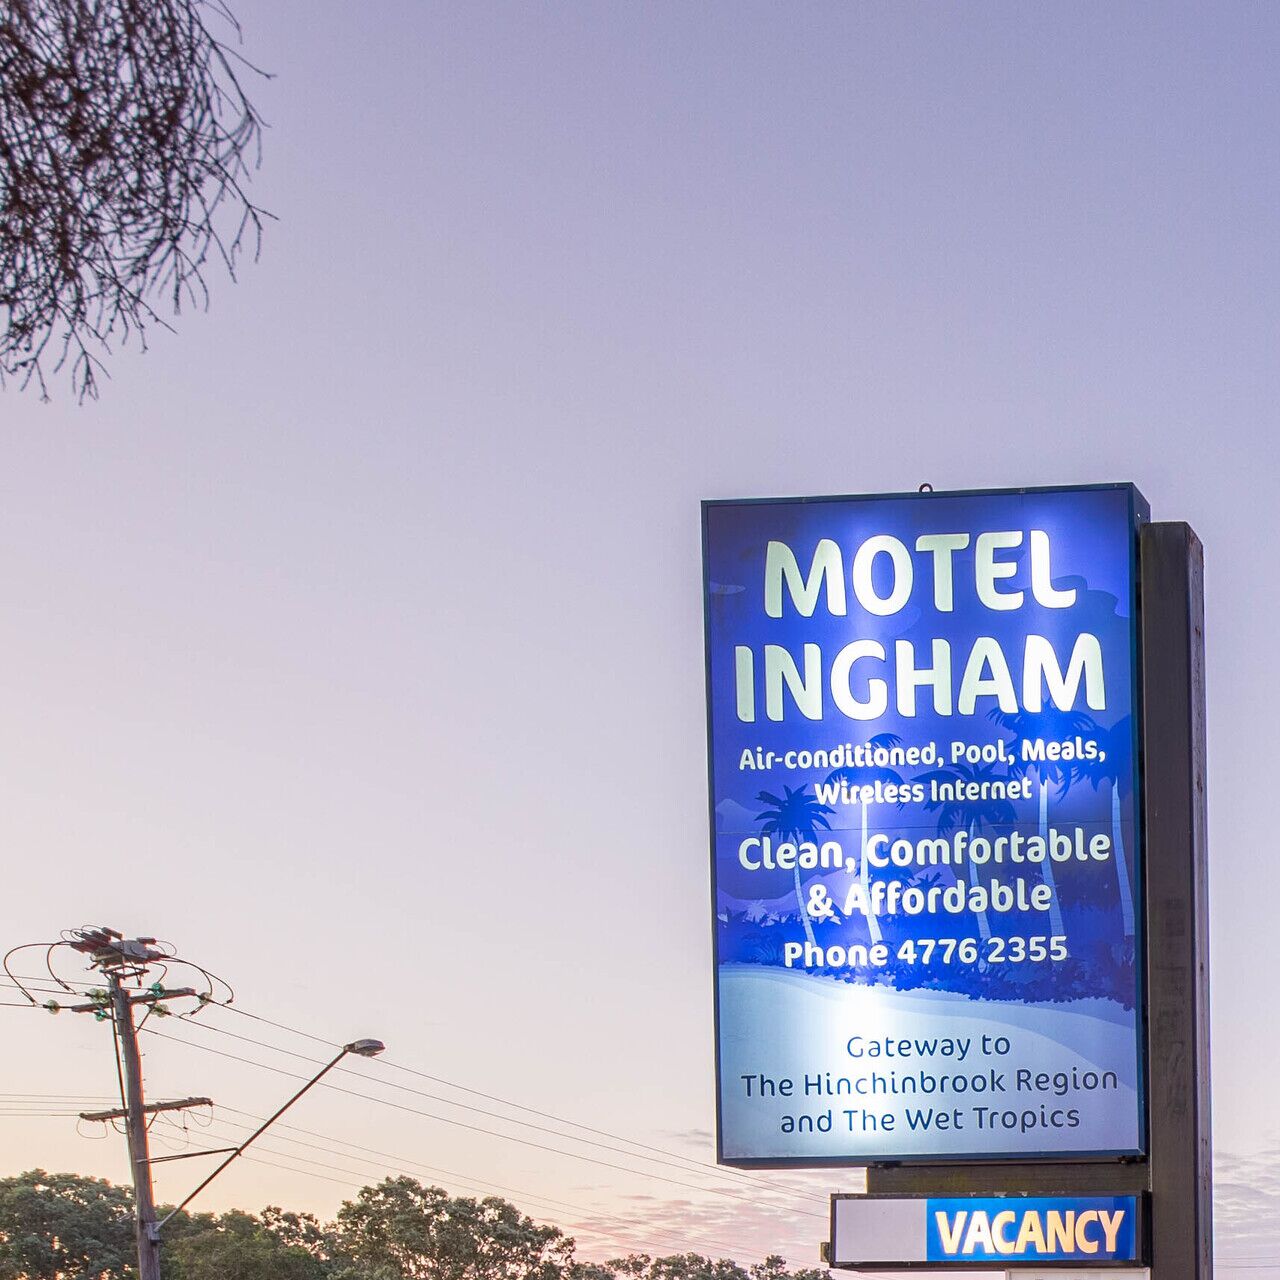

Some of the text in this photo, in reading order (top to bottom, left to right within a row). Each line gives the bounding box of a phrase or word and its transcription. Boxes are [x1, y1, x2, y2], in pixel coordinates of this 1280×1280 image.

[764, 529, 1077, 618] MOTEL
[734, 632, 1106, 723] INGHAM
[738, 735, 1106, 771] Air-conditioned, Pool, Meals,
[814, 776, 1033, 806] Wireless Internet
[738, 826, 1111, 873] Clean, Comfortable
[806, 877, 1053, 918] & Affordable
[783, 934, 1068, 968] Phone 4776 2355
[846, 1033, 1012, 1061] Gateway to
[740, 1067, 1118, 1098] The Hinchinbrook Region
[780, 1103, 1081, 1134] and The Wet Tropics
[934, 1208, 1126, 1256] VACANCY
